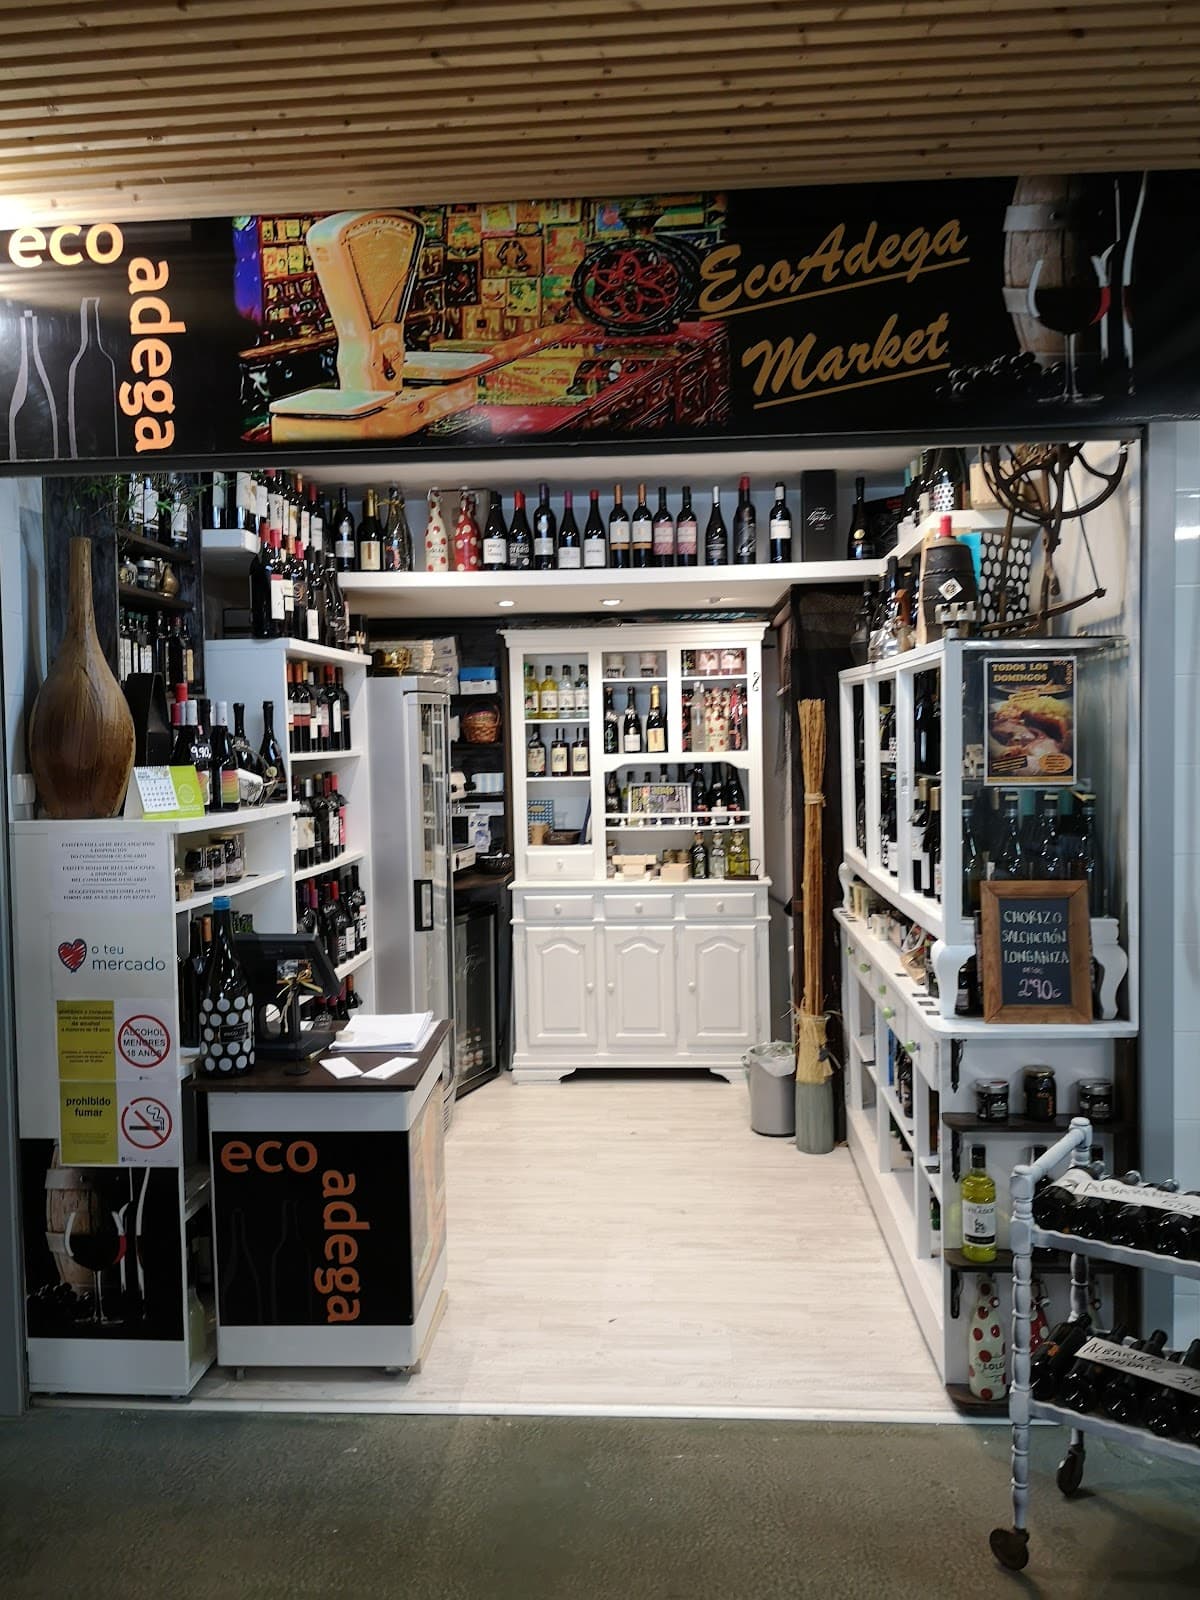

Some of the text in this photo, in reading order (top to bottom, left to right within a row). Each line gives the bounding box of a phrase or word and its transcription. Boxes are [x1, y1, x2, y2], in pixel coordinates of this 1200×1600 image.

[8, 223, 124, 268] eco
[700, 217, 968, 312] EcoAdega
[119, 257, 187, 453] adega
[741, 312, 950, 397] Market
[992, 662, 1048, 671] TODOS LOS
[993, 673, 1048, 682] DOMINGOS
[1003, 911, 1062, 924] CHORIZO
[1002, 928, 1066, 944] SALCHICHÓN
[91, 944, 124, 955] o teu
[1003, 949, 1070, 965] LONGANIZA
[92, 957, 166, 972] mercado
[123, 1028, 165, 1037] ALCOHOL
[123, 1039, 165, 1047] MENORES
[66, 1096, 111, 1107] prohibido
[74, 1108, 103, 1117] fumar
[220, 1140, 318, 1173] eco
[313, 1169, 370, 1323] adega
